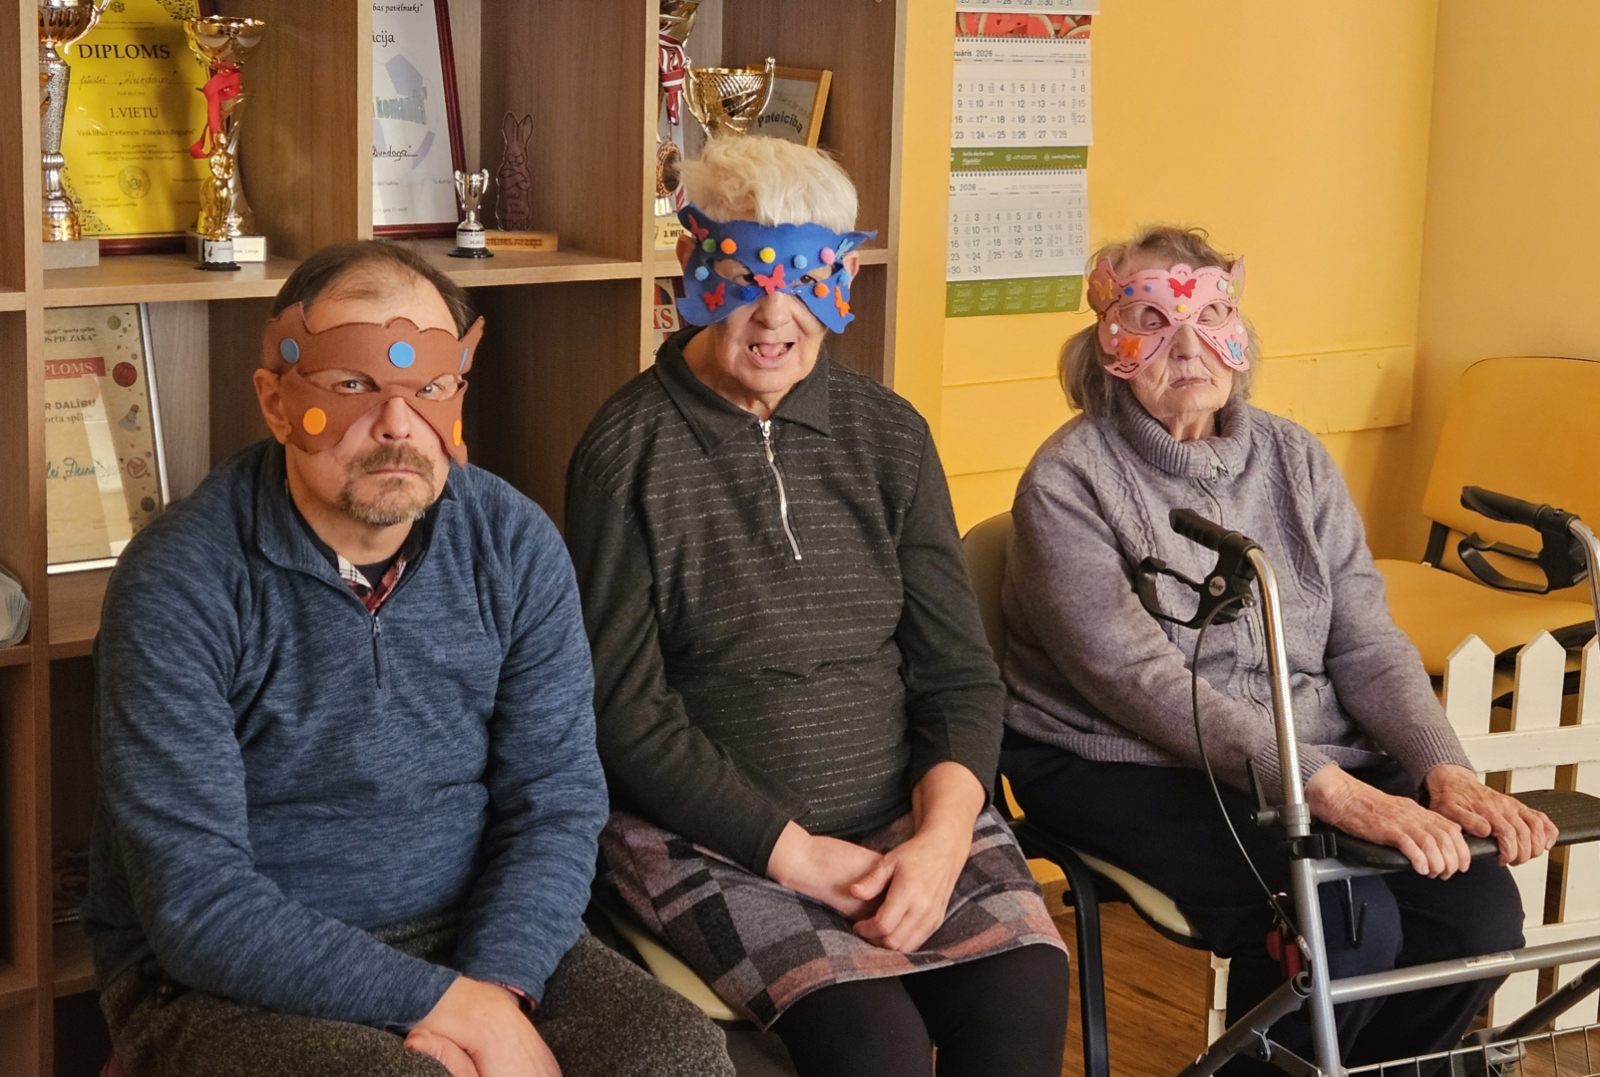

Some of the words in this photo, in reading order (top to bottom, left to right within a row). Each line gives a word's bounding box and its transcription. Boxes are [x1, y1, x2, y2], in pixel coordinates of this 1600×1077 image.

[78, 44, 170, 60] DIPLOMS
[957, 84, 962, 92] 2
[978, 84, 984, 92] 3
[1000, 84, 1004, 92] 4
[1020, 84, 1025, 92] 5
[1040, 84, 1046, 92] 6
[1061, 84, 1066, 92] 7
[1080, 84, 1086, 92] 8
[958, 100, 963, 108] 9
[976, 100, 984, 108] 10
[997, 100, 1003, 108] 11
[1018, 100, 1025, 108] 12
[1038, 100, 1046, 108] 13
[1058, 100, 1066, 108] 14
[1078, 100, 1086, 108] 15
[109, 107, 159, 119] 1.VIETU
[955, 131, 964, 139] 23
[976, 131, 985, 139] 24
[997, 131, 1006, 139] 25
[1018, 131, 1026, 139] 26
[1038, 131, 1046, 139] 27
[1058, 131, 1067, 139] 28
